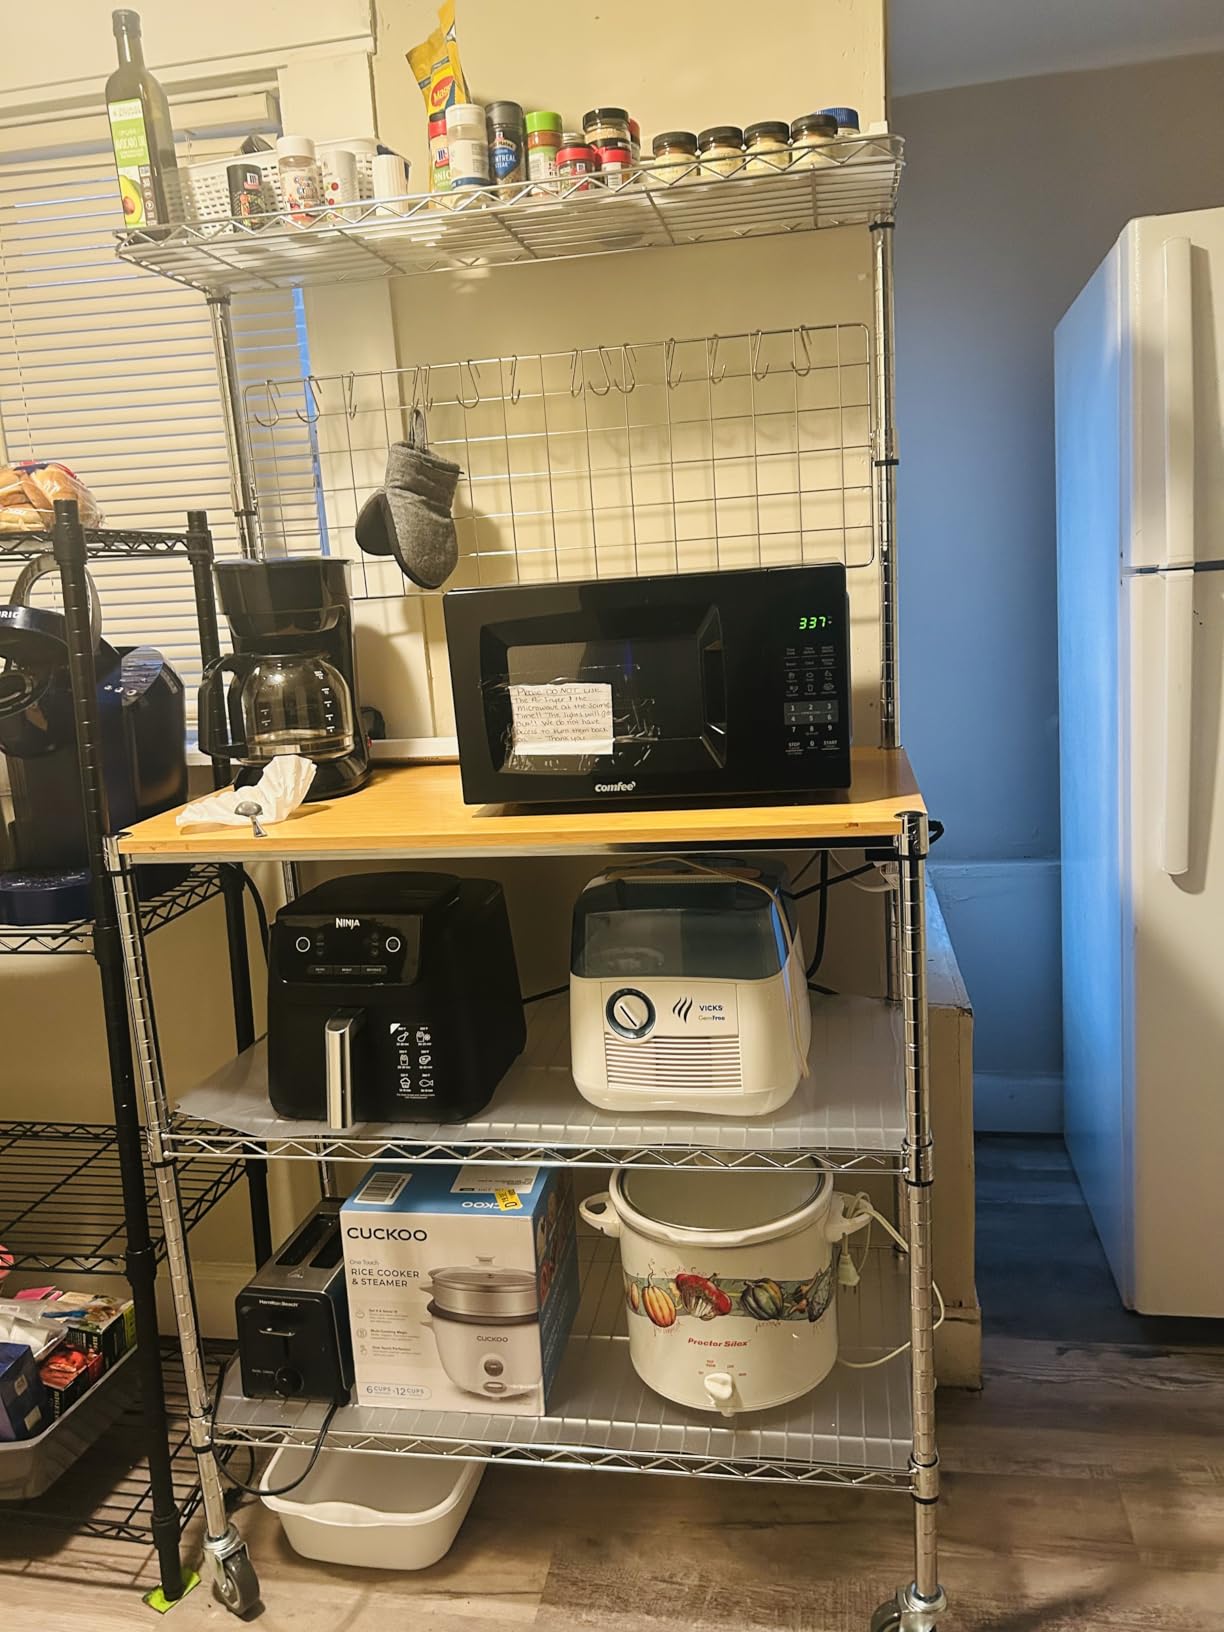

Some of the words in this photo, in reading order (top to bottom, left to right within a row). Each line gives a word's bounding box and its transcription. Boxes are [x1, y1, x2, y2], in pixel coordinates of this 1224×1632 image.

[347, 1227, 427, 1241] CUCKOO
[351, 1268, 374, 1276] RICE
[377, 1269, 420, 1278] COOKER
[361, 1278, 408, 1287] STEAMER
[477, 1335, 509, 1343] CUCKOO
[688, 1337, 723, 1347] Proctor
[723, 1340, 748, 1348] Silex
[366, 1385, 373, 1394] 6
